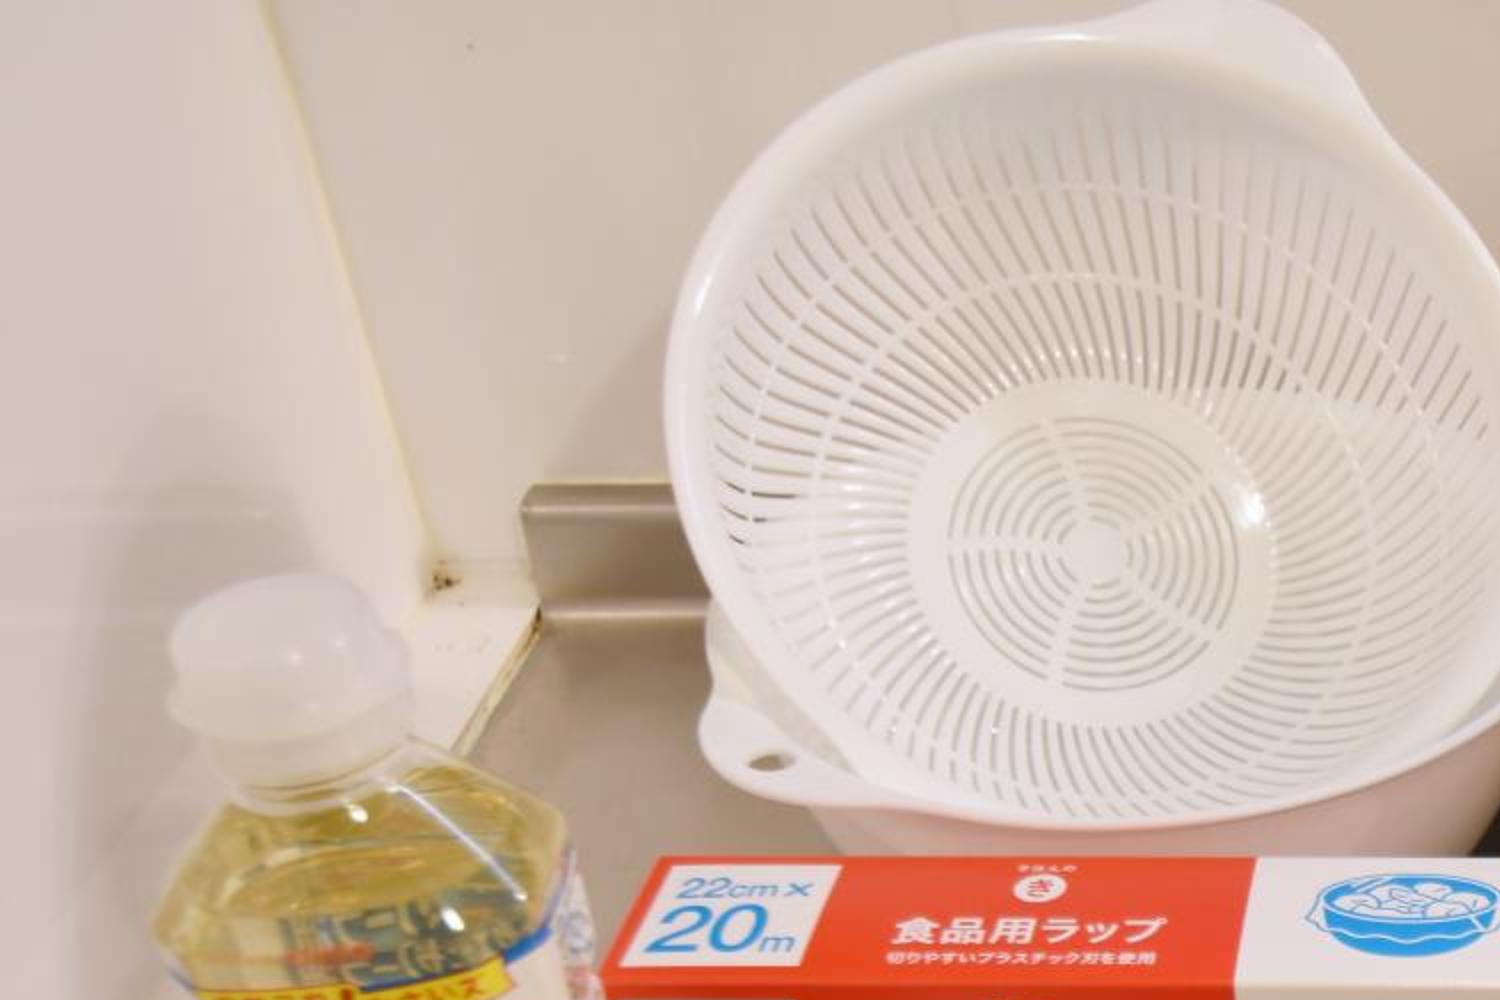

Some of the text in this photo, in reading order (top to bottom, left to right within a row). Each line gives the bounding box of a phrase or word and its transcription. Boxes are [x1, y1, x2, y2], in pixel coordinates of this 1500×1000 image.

[643, 902, 796, 955] 20m
[891, 915, 1168, 945] 食品用ラップ
[886, 951, 1157, 965] 切りやすいプラスチック刃を使用
